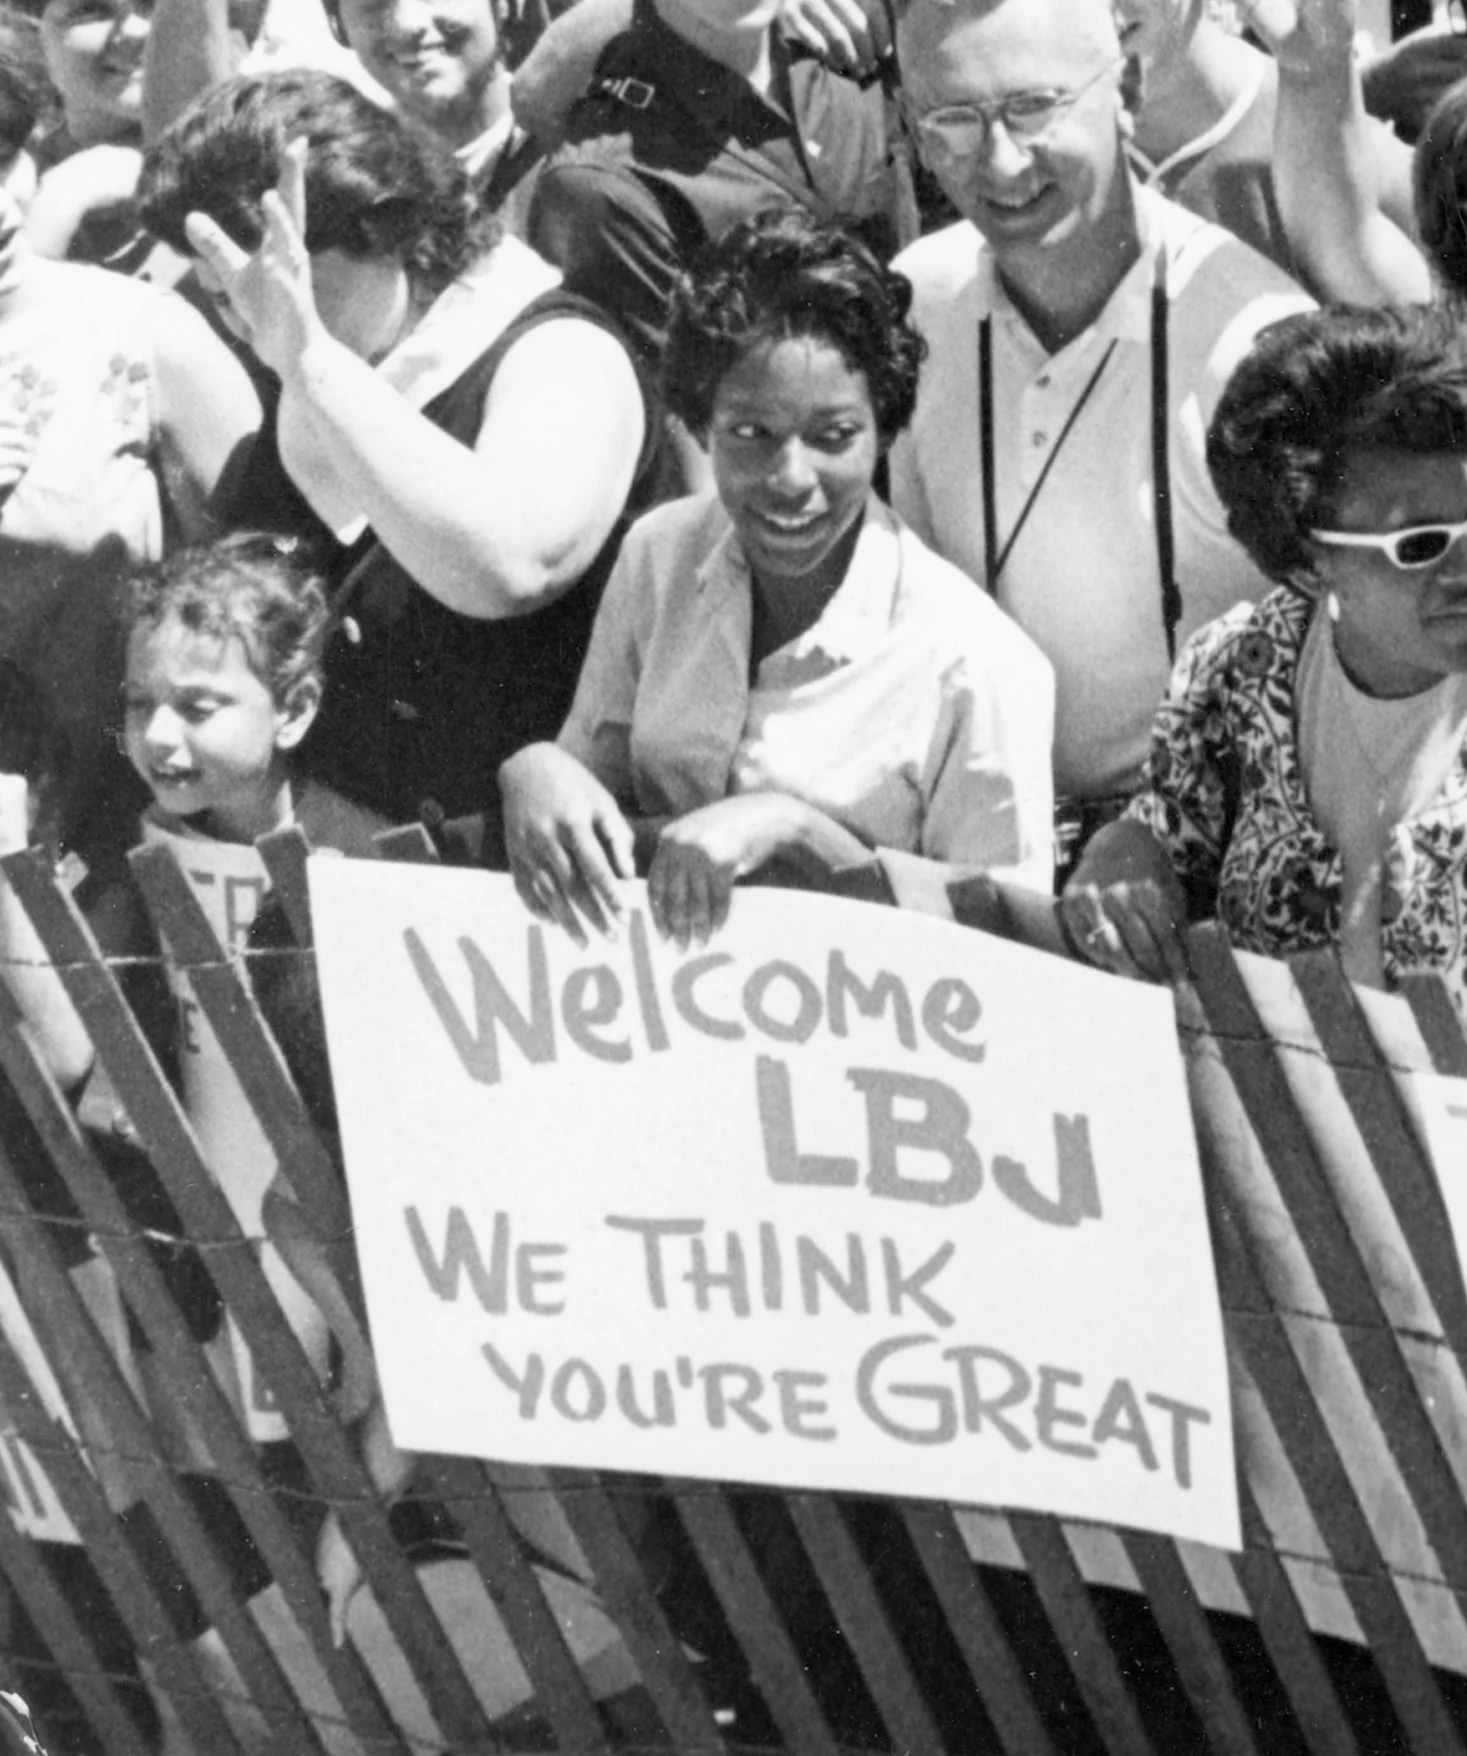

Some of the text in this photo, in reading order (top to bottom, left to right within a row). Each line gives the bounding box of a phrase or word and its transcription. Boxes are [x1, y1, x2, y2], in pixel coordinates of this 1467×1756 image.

[404, 908, 986, 1084] Welcome
[755, 1054, 1103, 1227] LBJ
[404, 1206, 568, 1315] WE
[604, 1214, 956, 1328] THINK
[480, 1342, 837, 1441] YOU'RE
[855, 1333, 1211, 1490] GREAT
